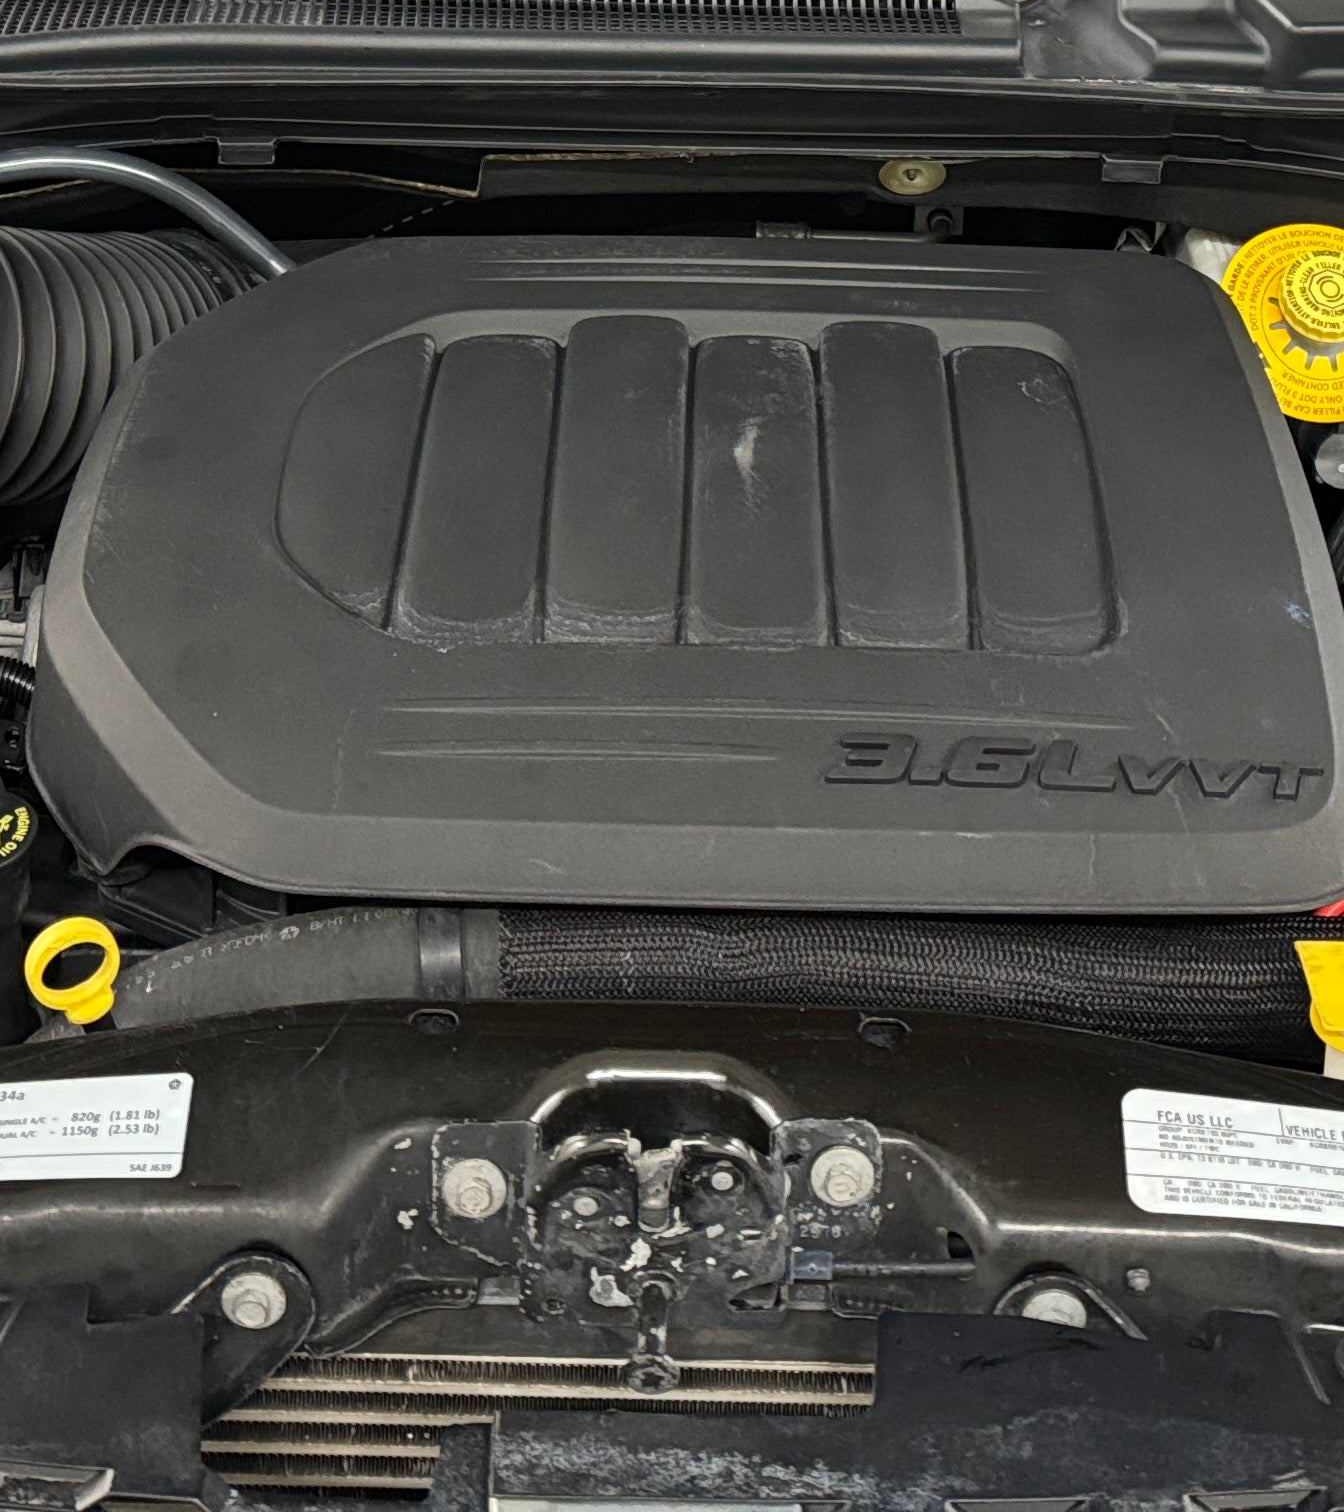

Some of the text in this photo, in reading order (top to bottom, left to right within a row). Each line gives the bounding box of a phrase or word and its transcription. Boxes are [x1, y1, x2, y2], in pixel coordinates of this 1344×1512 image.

[1278, 232, 1287, 241] LE
[1289, 230, 1331, 239] BOUCHON
[1334, 234, 1344, 242] DE
[1250, 261, 1277, 304] PROVENANT
[1249, 313, 1258, 331] DOT
[1292, 390, 1298, 399] 3
[1299, 394, 1317, 404] DOT
[1319, 395, 1343, 405] ONLY
[1293, 404, 1311, 414] CAP
[824, 732, 1324, 801] 3.6L VVT
[11, 807, 30, 842] ENGINE
[29, 1116, 46, 1124] A/C
[70, 1112, 101, 1124] 820g
[109, 1109, 140, 1121] (1.81
[143, 1109, 160, 1121] lb)
[1156, 1110, 1234, 1128] FCA US LLC
[19, 1130, 36, 1138] A/C
[61, 1125, 98, 1138] 1150g
[108, 1123, 139, 1135] (2.53
[142, 1123, 159, 1135] lb)
[1285, 1124, 1336, 1141] VEHICLE
[129, 1163, 172, 1172] SAE J639
